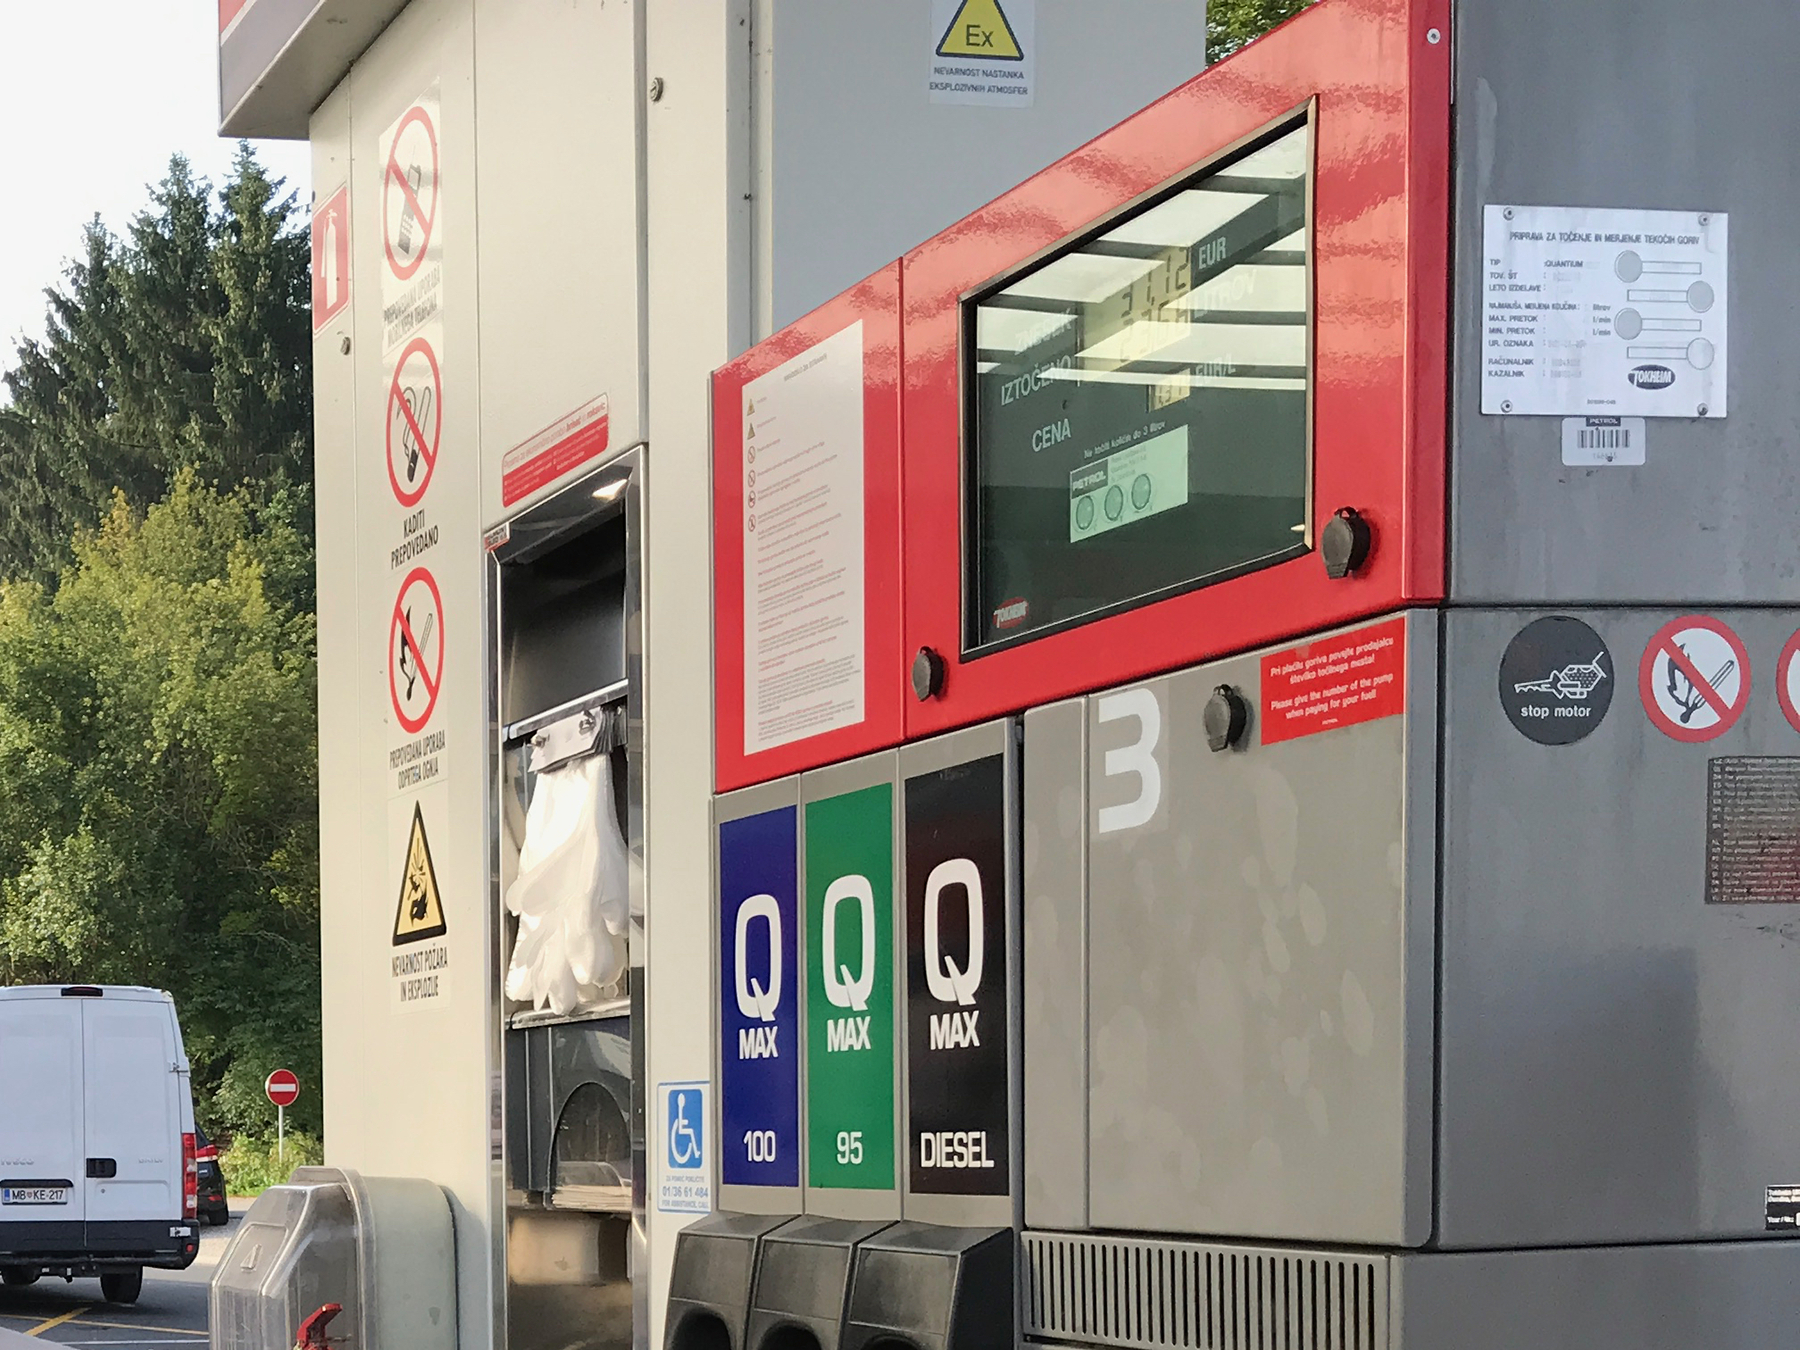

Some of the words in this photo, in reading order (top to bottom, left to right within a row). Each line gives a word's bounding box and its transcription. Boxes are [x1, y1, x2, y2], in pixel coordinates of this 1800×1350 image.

[966, 24, 994, 48] Ex
[934, 67, 980, 77] NEVARNOST
[982, 70, 1024, 79] NASTANKA
[929, 82, 985, 93] EKSPLOZIVNIH
[987, 85, 1028, 95] ATMOSFER
[1509, 231, 1544, 241] PRIPRAVA
[1546, 232, 1557, 242] ZA
[1604, 233, 1642, 244] MERJENJE
[1677, 235, 1700, 245] GORIV
[1199, 236, 1227, 269] EUR
[1489, 258, 1501, 267] TIP
[1489, 284, 1507, 292] LETO
[1506, 327, 1536, 335] PRETOK
[1509, 315, 1539, 323] PRETOK
[1503, 339, 1534, 347] OZNAKA
[1488, 356, 1534, 366] RAČUNALNIK
[1488, 370, 1525, 378] KAZALNIK
[1001, 355, 1072, 406] IZTOČENO
[1631, 370, 1672, 387] TOKHEIM
[1031, 419, 1072, 452] CENA
[1072, 469, 1107, 492] PETROL
[403, 508, 425, 539] KADITI
[391, 524, 439, 570] PREPOVEDANO
[1270, 666, 1282, 677] Pri
[1305, 655, 1328, 670] goriva
[1271, 698, 1293, 711] Please
[1294, 694, 1309, 707] give
[1309, 689, 1321, 701] the
[1322, 683, 1349, 699] number
[1350, 680, 1358, 691] of
[1359, 676, 1372, 688] the
[1373, 672, 1394, 686] pump
[1286, 708, 1304, 720] when
[1305, 702, 1329, 717] paying
[1330, 697, 1342, 709] for
[1342, 693, 1359, 708] your
[1520, 704, 1549, 720] stop
[1554, 704, 1591, 717] motor
[1099, 688, 1161, 834] 3
[822, 874, 876, 1011] Q
[924, 858, 984, 1006] Q
[392, 950, 424, 977] NEVARNOST
[424, 943, 448, 972] POŽARA
[735, 894, 782, 1022] Q
[400, 981, 406, 1002] IN
[407, 975, 439, 1001] EKSPLOZIJE
[739, 1026, 778, 1060] MAX
[827, 1016, 871, 1053] MAX
[929, 1010, 981, 1050] MAX
[743, 1130, 777, 1163] 100
[836, 1131, 863, 1165] 95
[920, 1130, 995, 1168] DIESEL
[12, 1190, 26, 1201] MB
[33, 1190, 63, 1201] KE-217
[684, 1186, 692, 1198] 61
